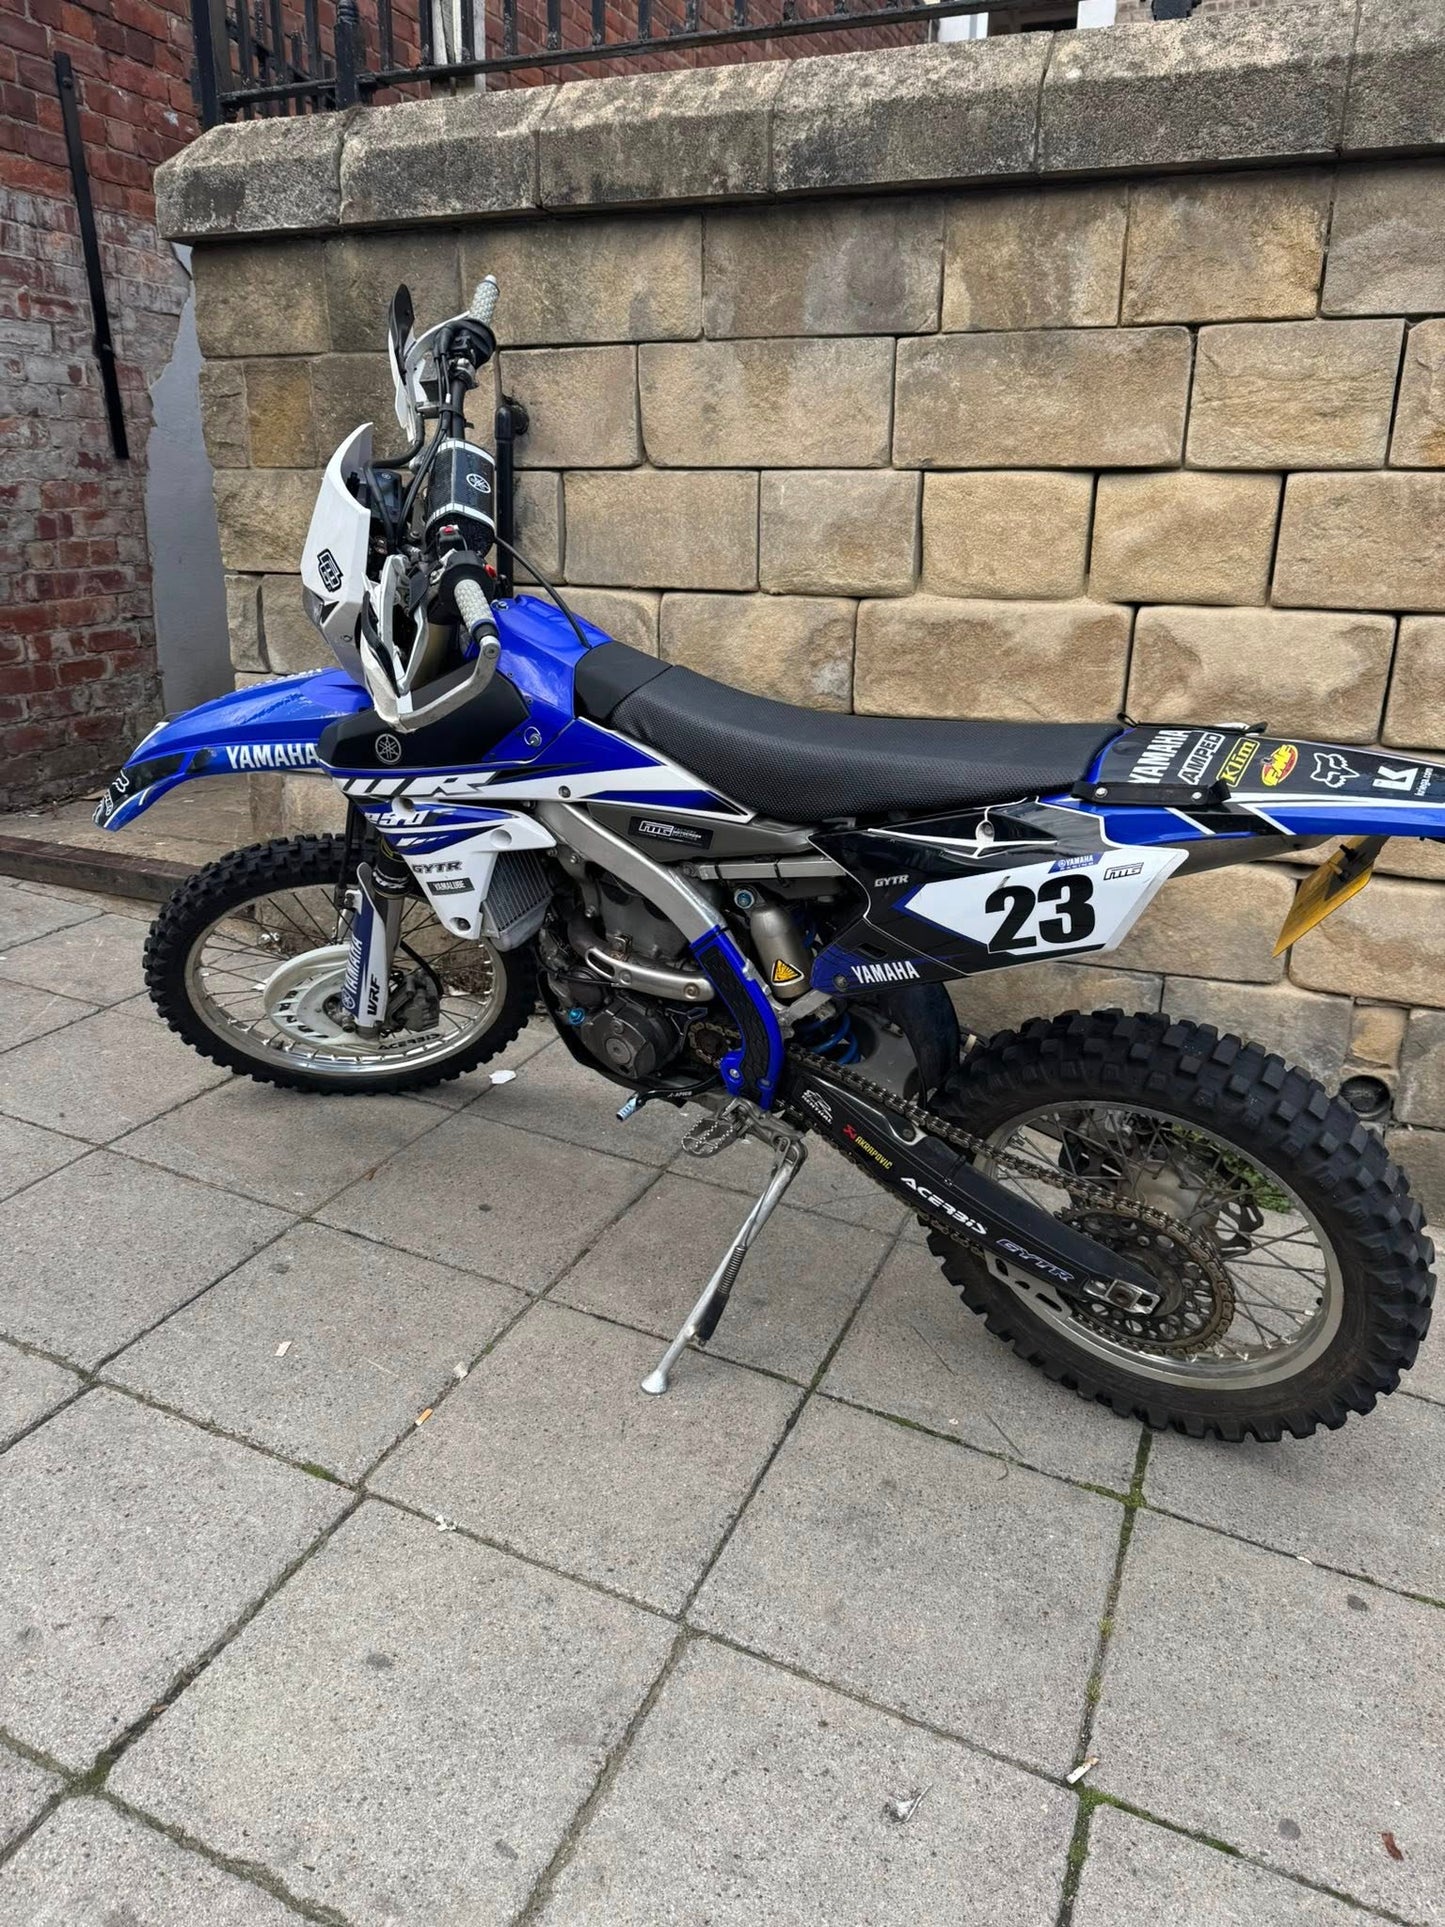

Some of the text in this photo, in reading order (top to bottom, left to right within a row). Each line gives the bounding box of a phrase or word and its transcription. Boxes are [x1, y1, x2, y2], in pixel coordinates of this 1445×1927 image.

[225, 742, 320, 769] YAMAHA
[1128, 730, 1192, 784] YAMAHA
[1180, 733, 1222, 784] AMPED
[412, 860, 463, 873] GYTR
[1066, 854, 1095, 866] YAMAHA
[432, 878, 467, 891] YAMALUBE
[874, 874, 910, 888] GYTR
[984, 873, 1096, 954] 23
[343, 932, 363, 995] YAMAHA
[850, 960, 921, 984] YAMAHA
[366, 973, 381, 1016] WRF
[996, 1238, 1076, 1283] GYTR
